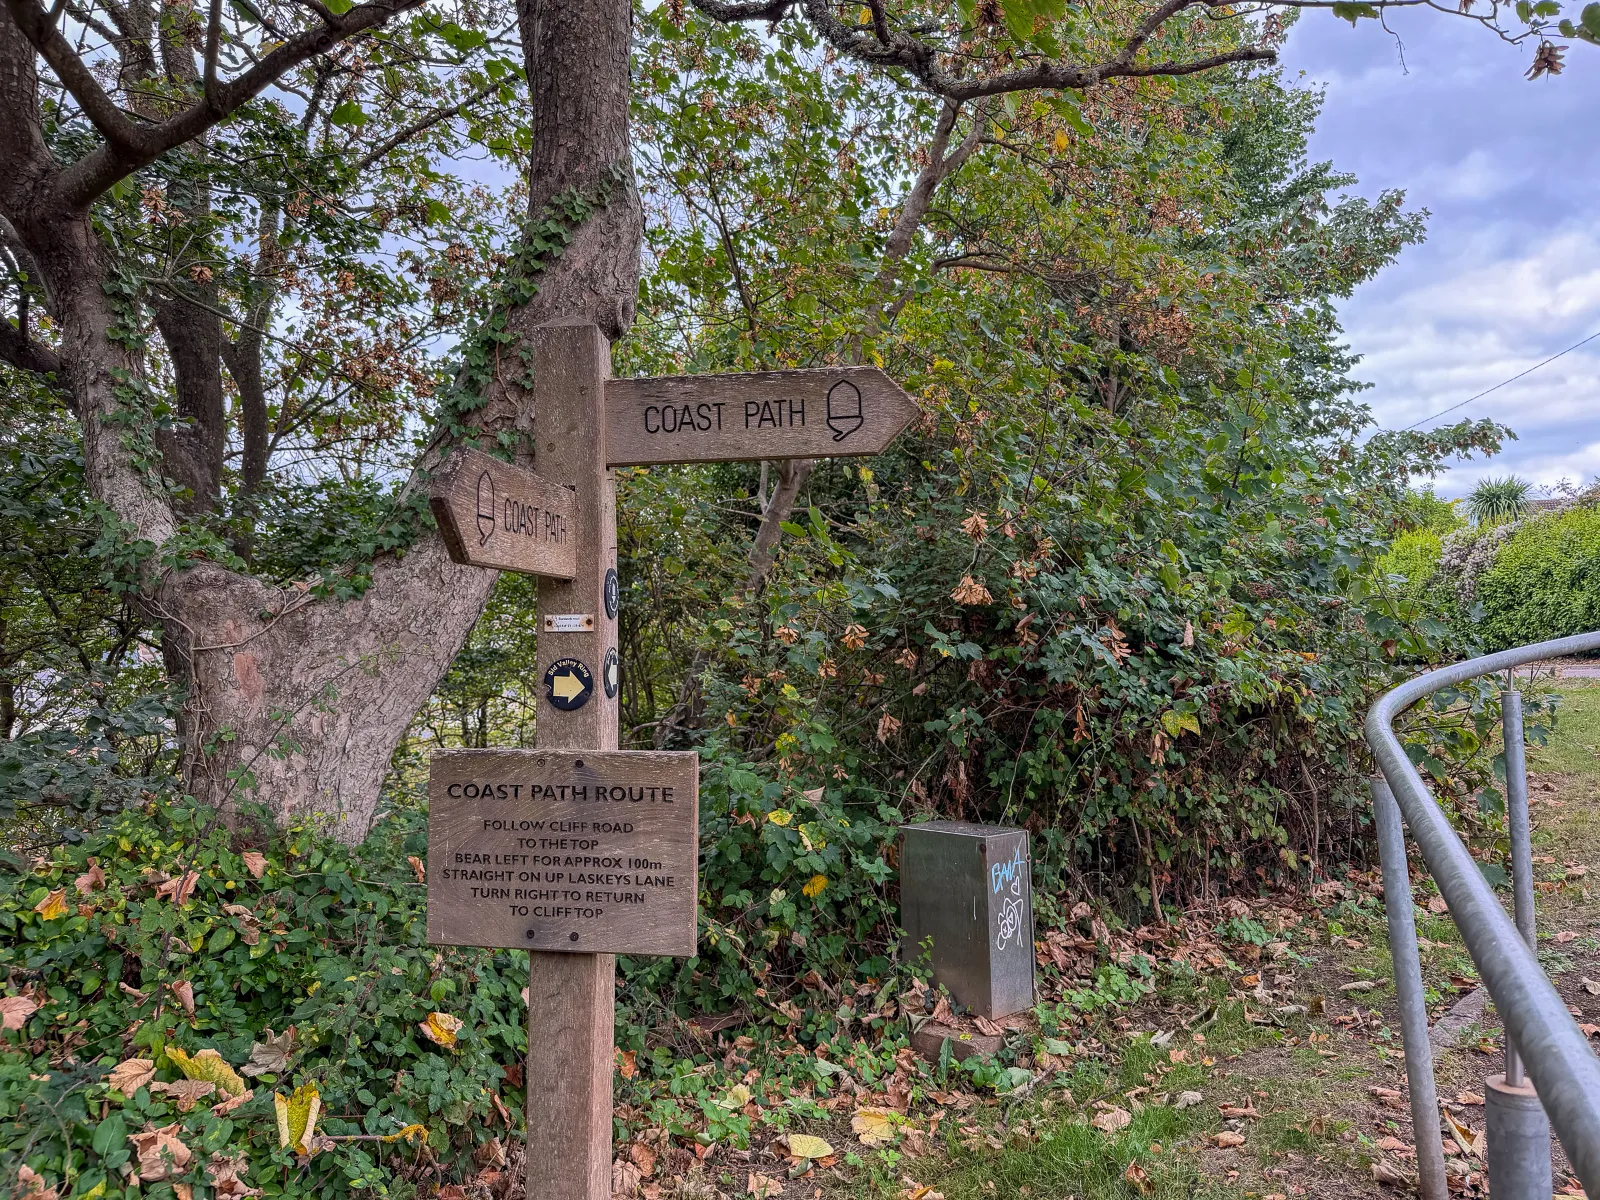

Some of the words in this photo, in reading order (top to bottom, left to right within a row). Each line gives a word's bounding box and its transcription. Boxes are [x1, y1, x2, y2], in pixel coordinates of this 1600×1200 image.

[644, 403, 725, 434] COAST
[744, 398, 806, 429] PATH
[504, 498, 539, 538] COAST
[545, 509, 567, 545] PATH
[557, 660, 577, 668] Valley
[577, 663, 590, 678] Ring
[447, 783, 523, 801] COAST
[531, 784, 588, 801] PATH
[596, 785, 674, 803] ROUTE
[483, 820, 545, 832] FOLLOW
[550, 821, 588, 833] CLIFF
[593, 822, 634, 834] ROAD
[517, 838, 537, 849] TO
[539, 838, 568, 850] THE
[570, 839, 599, 850] TOP
[455, 853, 490, 864] BEAR
[495, 854, 529, 866] LEFT
[533, 855, 561, 867] FOR
[564, 856, 623, 869] APPROX
[627, 858, 662, 870] 100m
[443, 869, 514, 882] STRAIGHT
[519, 871, 541, 883] ON
[545, 872, 564, 884] UP
[568, 873, 631, 886] LASKEYS
[635, 875, 674, 888] LANE
[471, 887, 510, 899] TURN
[514, 888, 559, 901] RIGHT
[562, 890, 582, 901] TO
[586, 891, 645, 904] RETURN
[509, 905, 529, 917] TO
[533, 906, 572, 918] CLIFF
[573, 907, 603, 919] TOP
